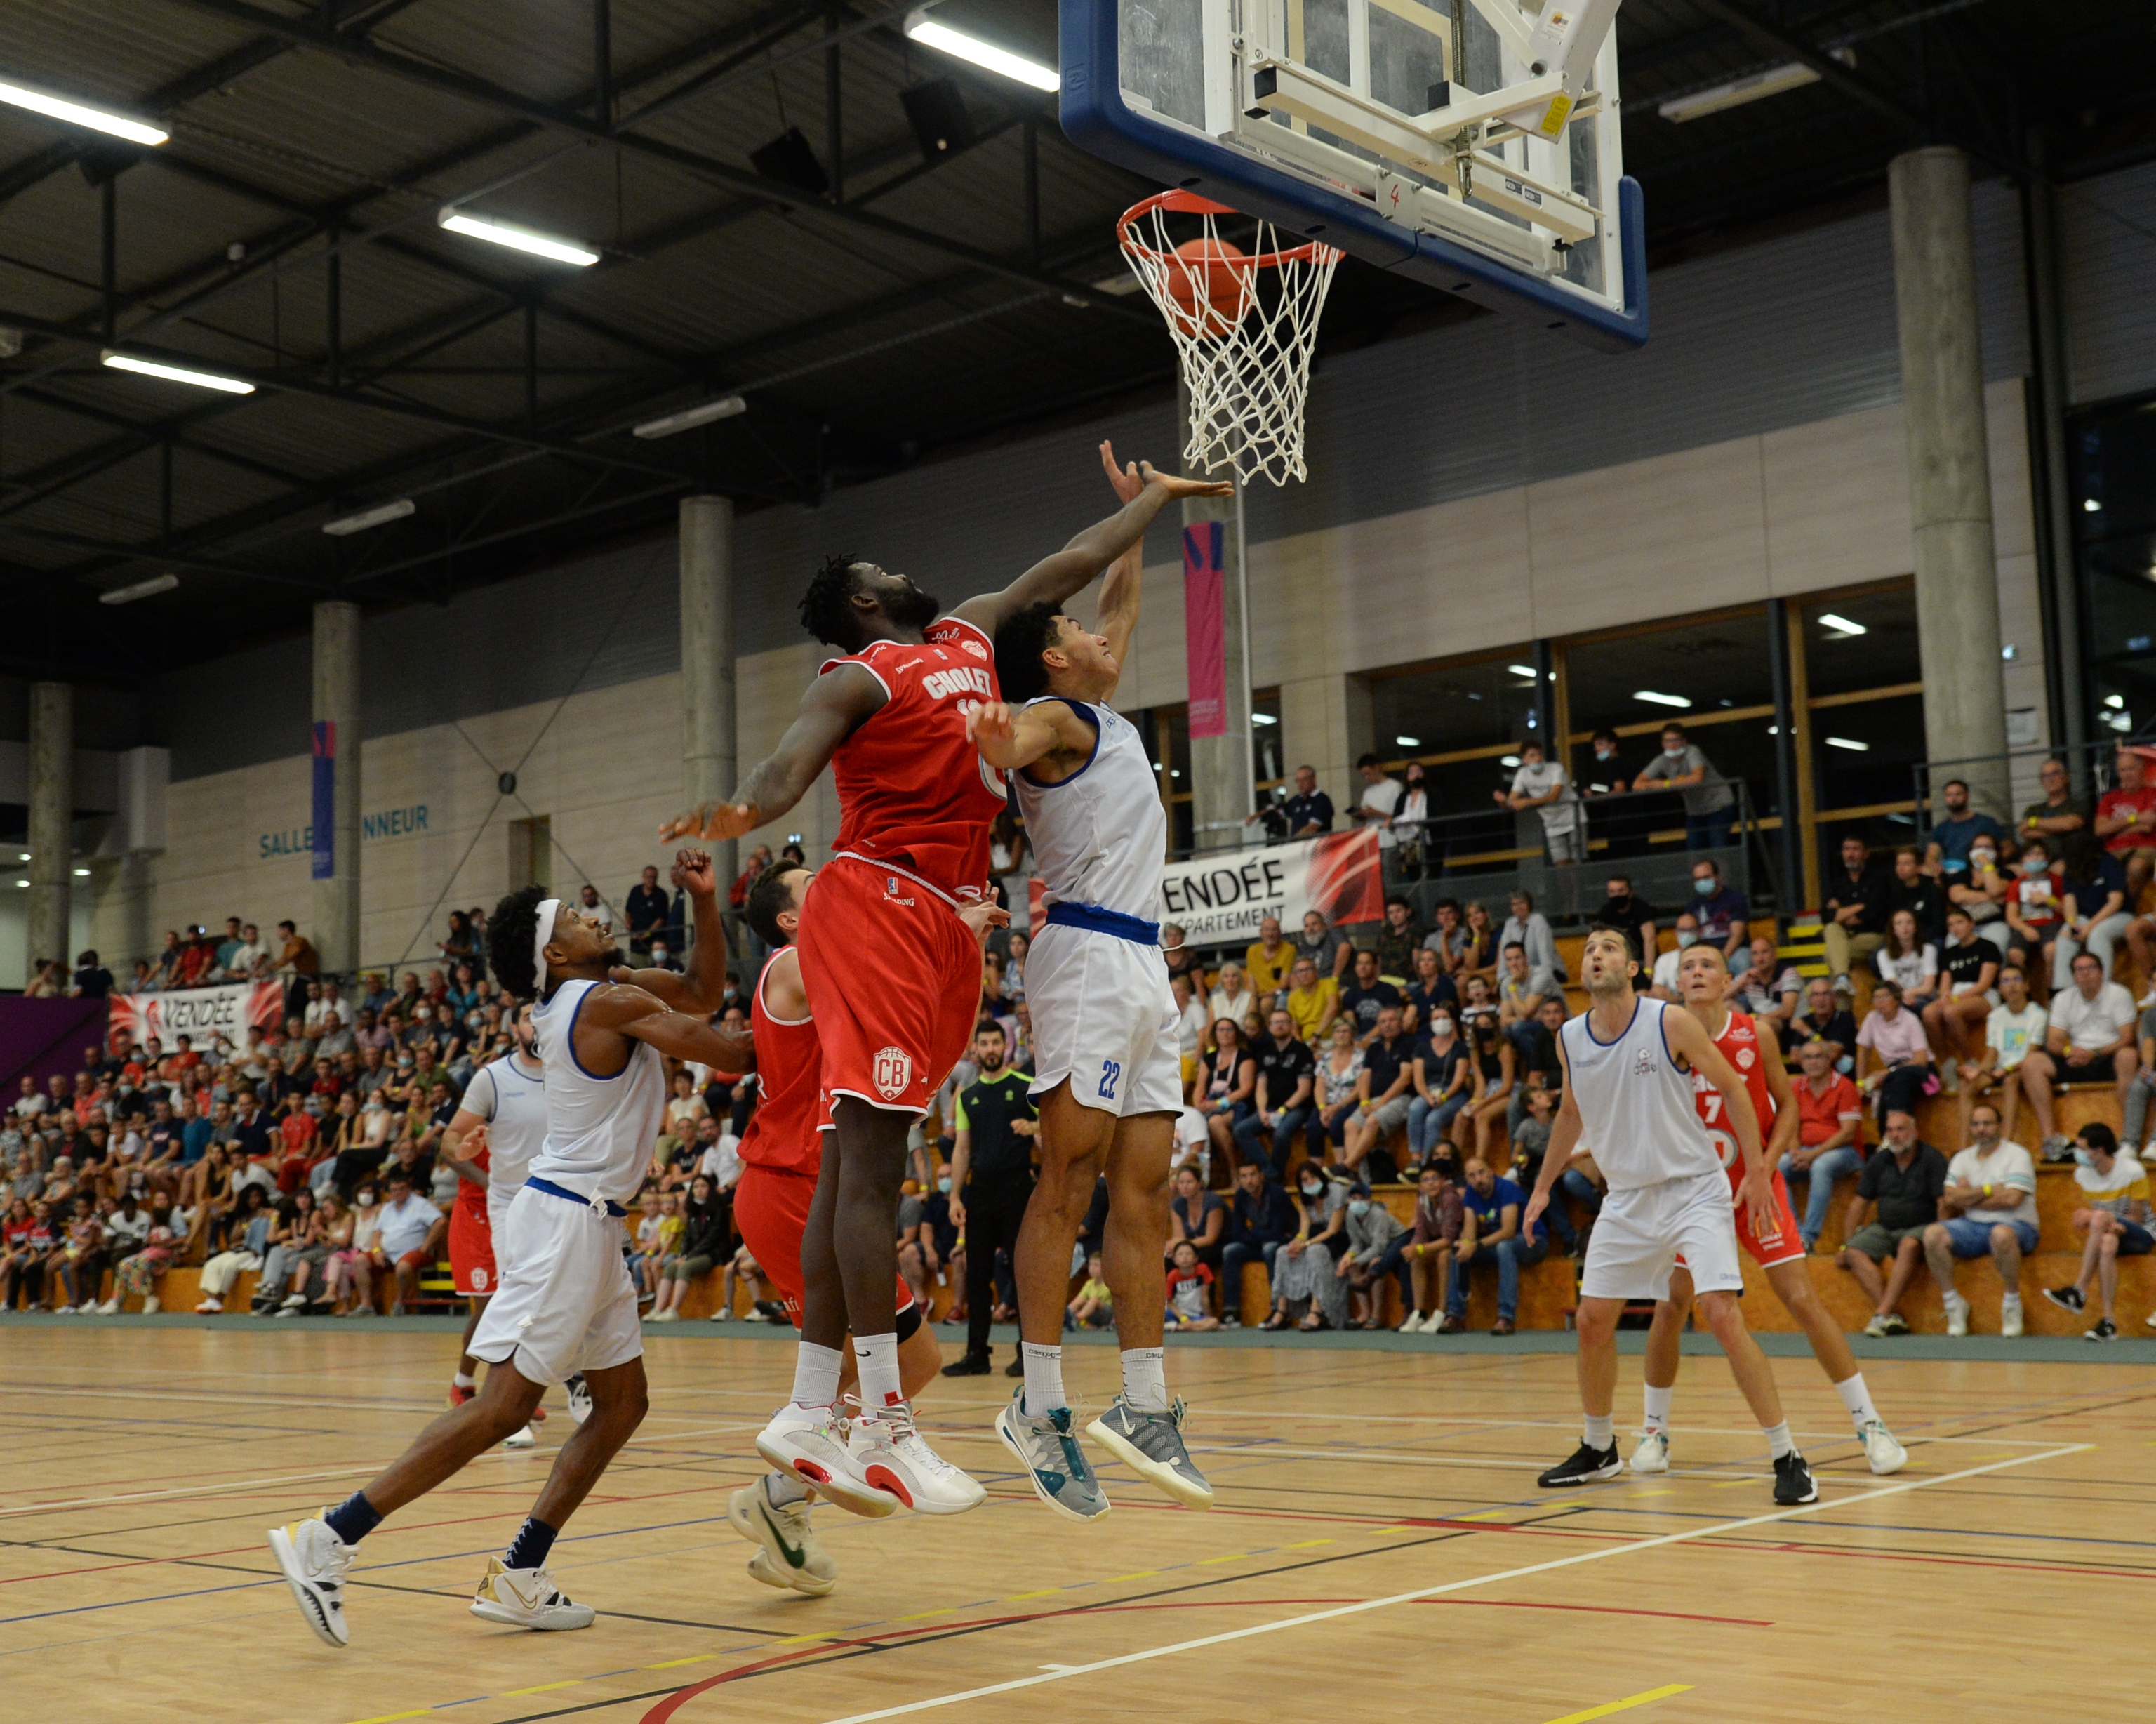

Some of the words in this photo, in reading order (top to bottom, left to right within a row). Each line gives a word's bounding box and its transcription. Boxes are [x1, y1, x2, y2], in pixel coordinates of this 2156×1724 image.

[1390, 184, 1399, 208] 4
[922, 667, 993, 699] CHOLET
[363, 805, 429, 840] NNEUR
[260, 826, 314, 858] SALLE
[1162, 856, 1284, 913] ENDÉE
[163, 992, 237, 1028] VENDÉE
[877, 1059, 905, 1087] CB
[1098, 1059, 1121, 1100] 22
